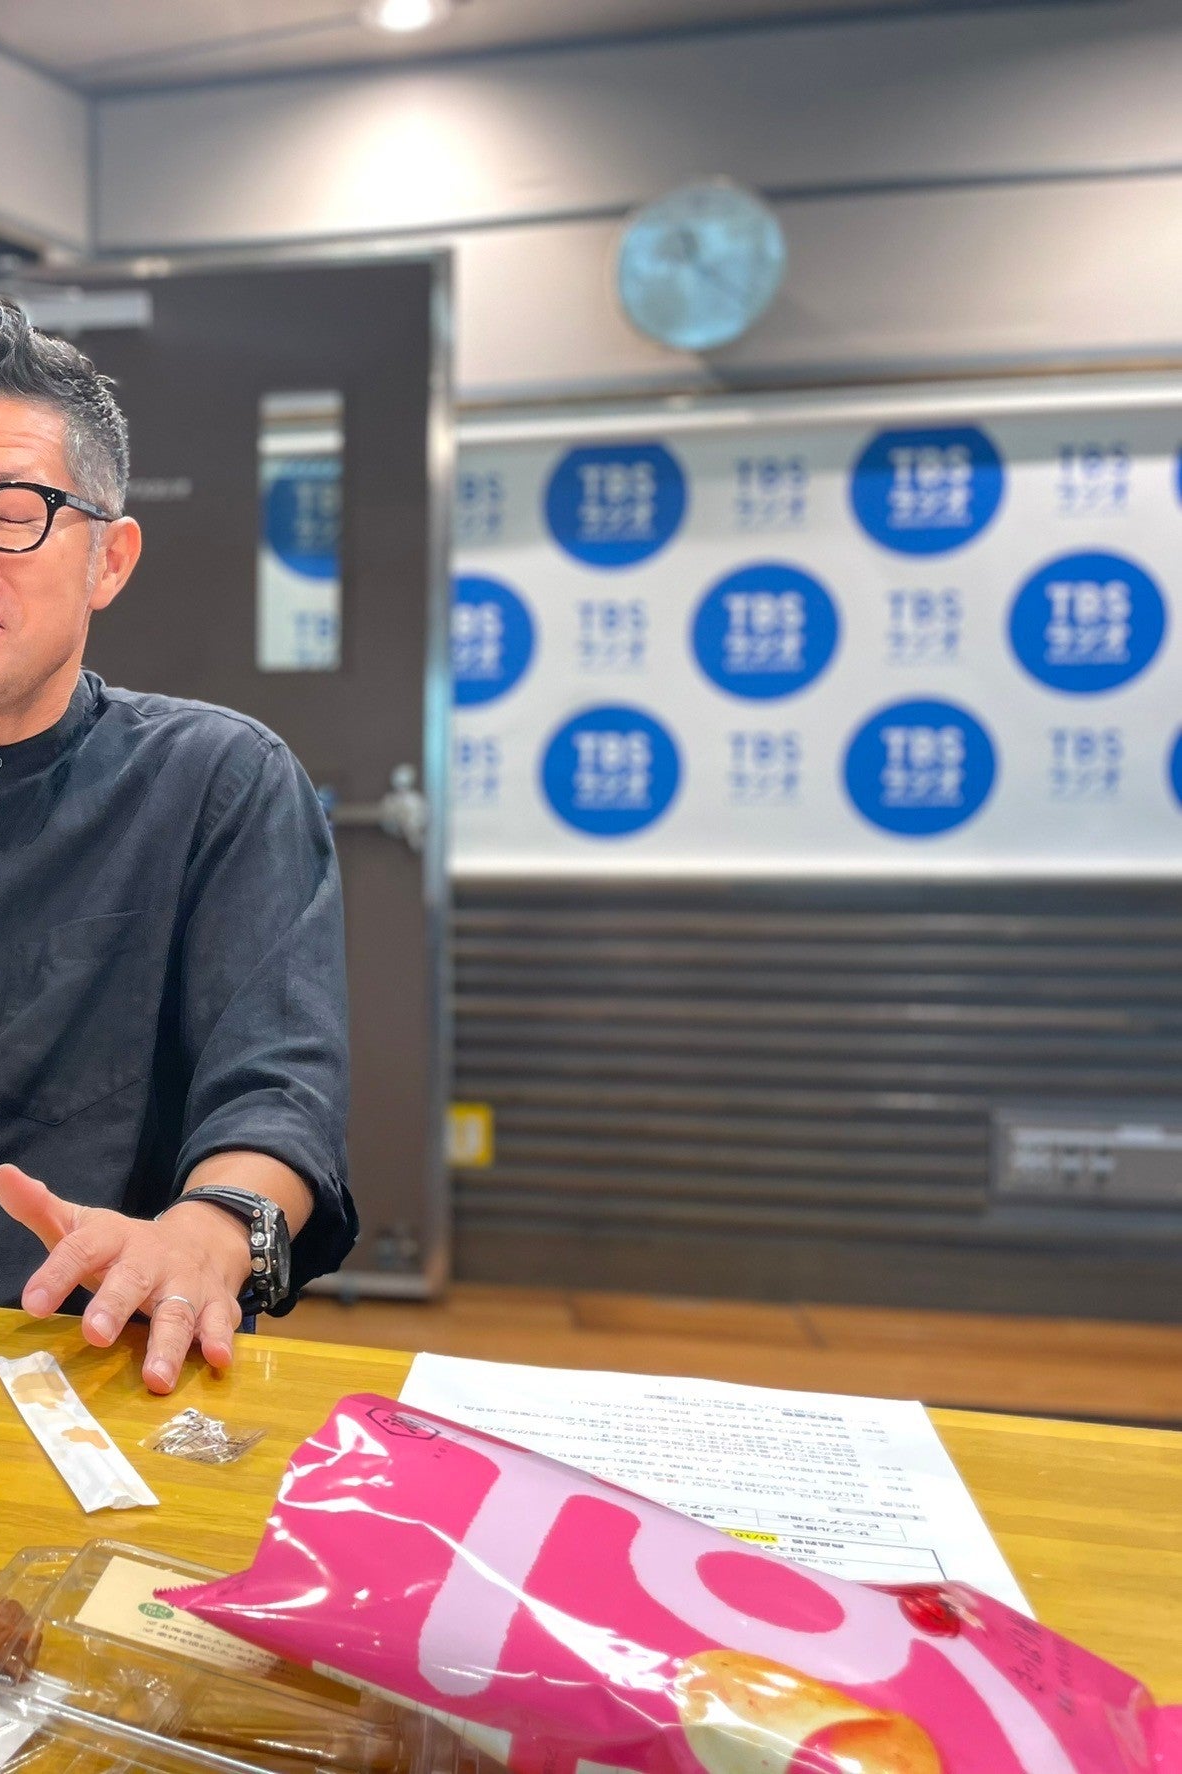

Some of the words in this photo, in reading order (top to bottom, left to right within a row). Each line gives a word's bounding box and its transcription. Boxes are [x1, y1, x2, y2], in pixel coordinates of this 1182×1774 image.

[734, 459, 807, 490] TBS
[890, 447, 971, 486] TBS
[1057, 444, 1130, 474] TBS
[457, 473, 503, 502] BS
[577, 465, 657, 501] TBS
[576, 600, 647, 633] TBS
[724, 592, 805, 631] TBS
[888, 589, 962, 622] TBS
[1046, 582, 1130, 622] TBS
[453, 604, 503, 637] BS
[454, 737, 499, 765] BS
[573, 732, 651, 771] TBS
[728, 733, 801, 763] TBS
[882, 727, 964, 766] TBS
[1050, 728, 1124, 759] TBS
